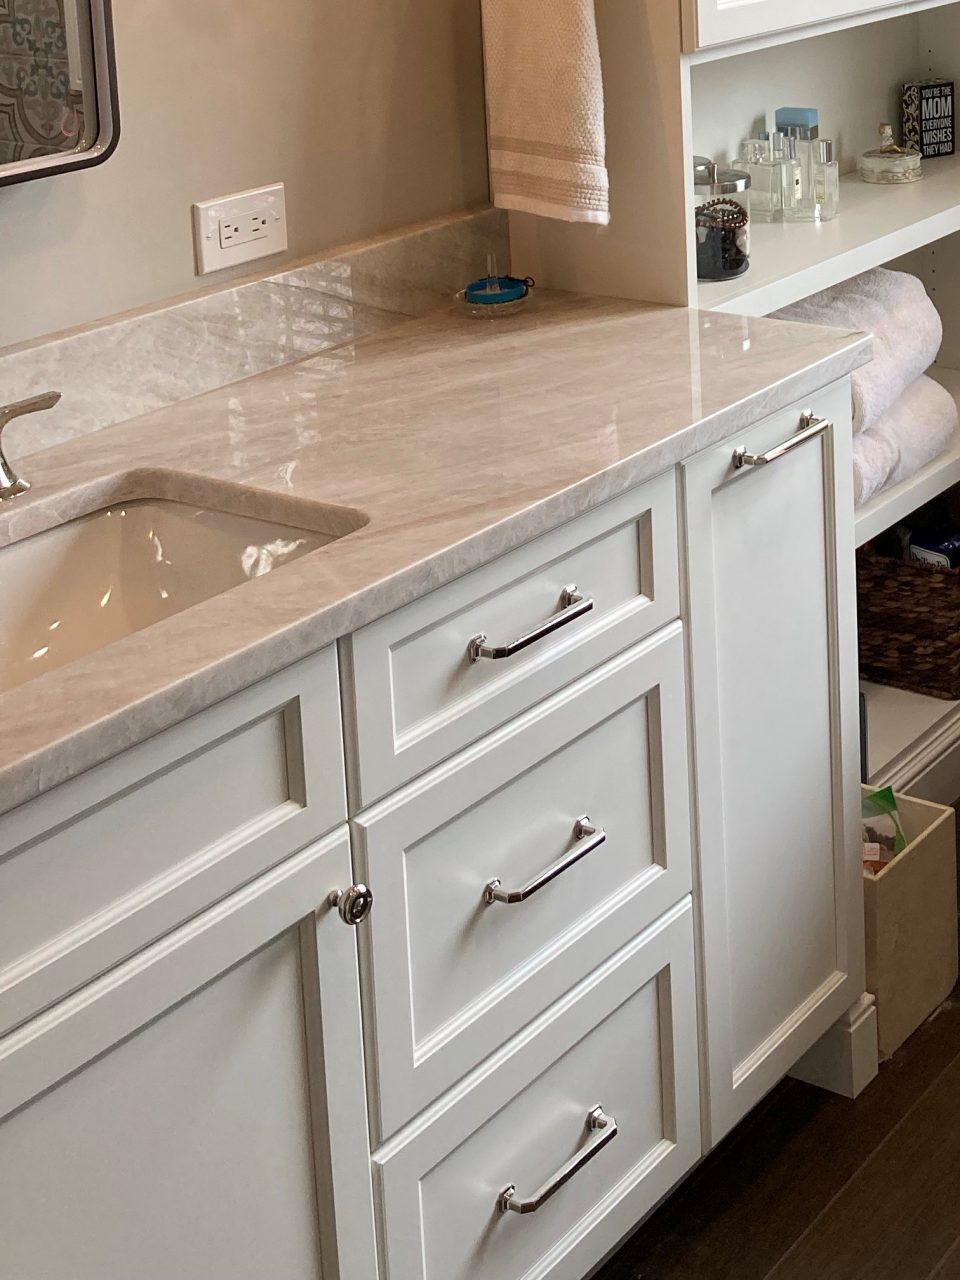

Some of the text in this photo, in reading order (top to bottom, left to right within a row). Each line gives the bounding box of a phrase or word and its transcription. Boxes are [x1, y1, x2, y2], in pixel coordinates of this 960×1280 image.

[942, 86, 952, 95] THE
[922, 96, 952, 120] MOM
[922, 117, 952, 130] EVERYONE
[922, 128, 952, 144] WISHES
[923, 142, 952, 156] THEY HAD
